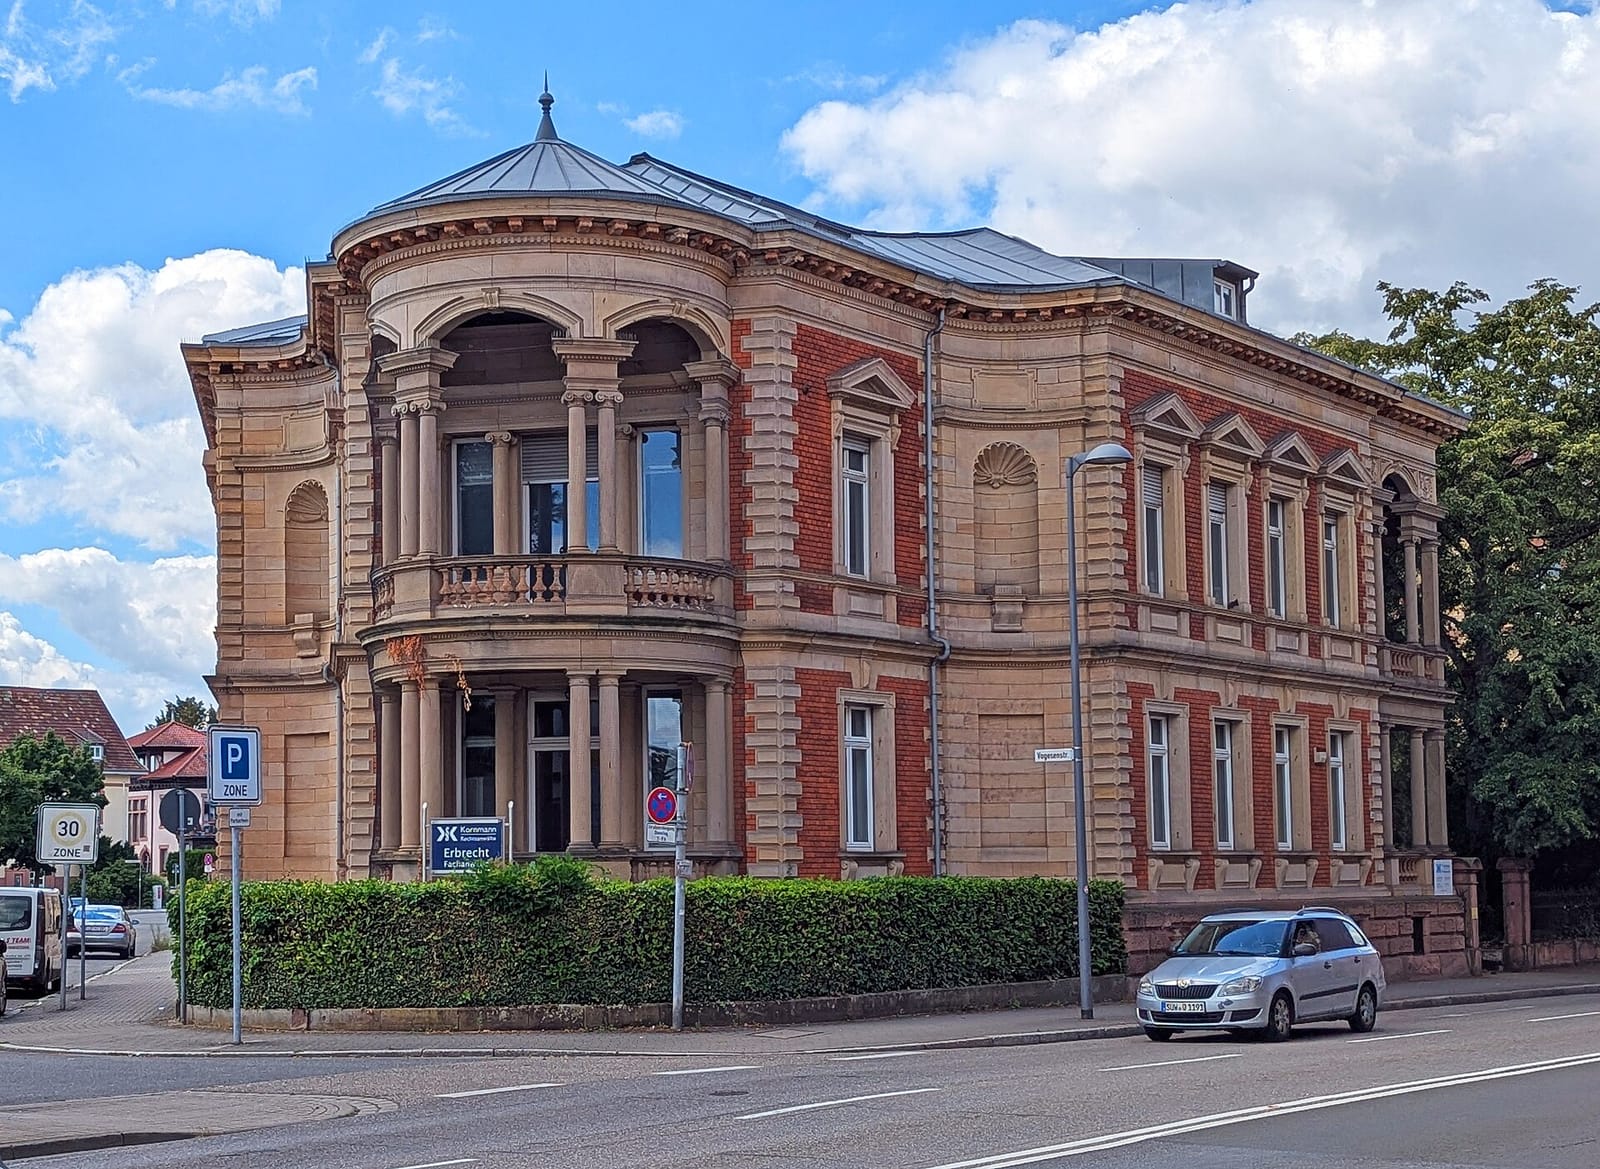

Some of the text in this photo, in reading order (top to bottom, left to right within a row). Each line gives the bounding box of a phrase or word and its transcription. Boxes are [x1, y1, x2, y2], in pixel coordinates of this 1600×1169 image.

[227, 743, 243, 774] P
[1036, 751, 1070, 761] Vogesenstr.
[223, 784, 248, 797] ZONE
[58, 820, 79, 837] 30
[460, 825, 497, 833] Kornmann
[53, 848, 81, 858] ZONE
[443, 847, 490, 858] Erbrecht
